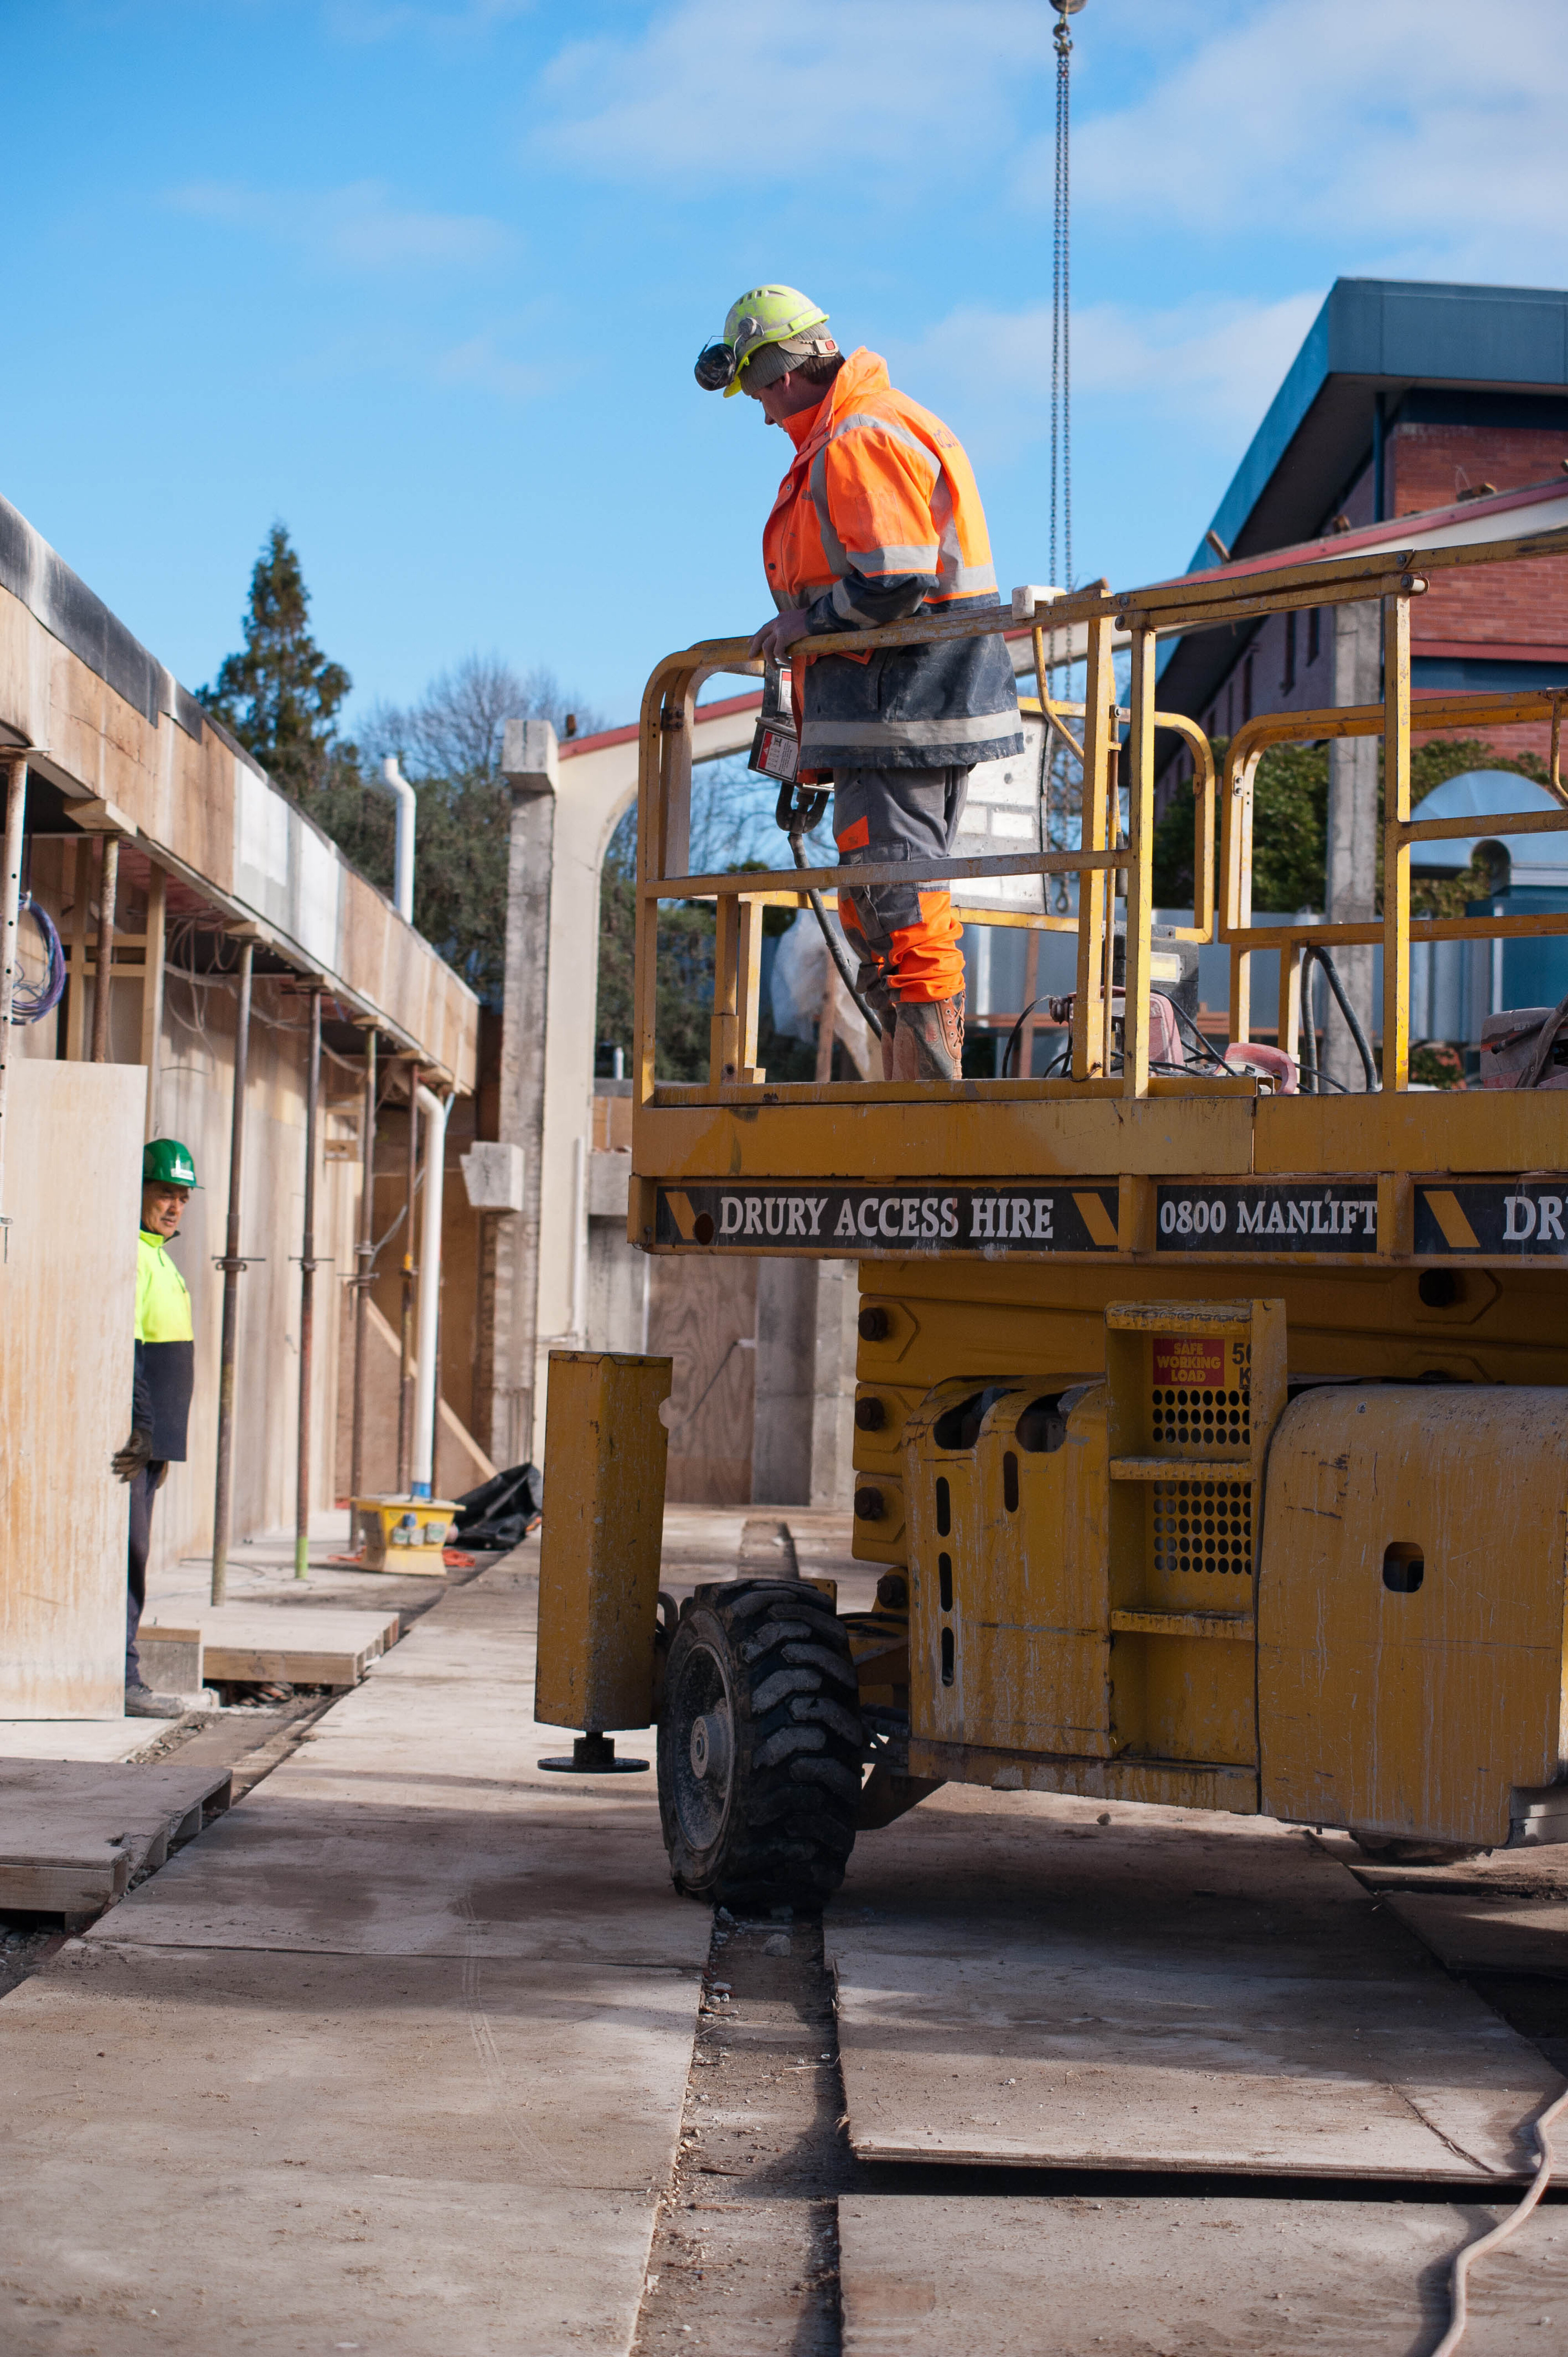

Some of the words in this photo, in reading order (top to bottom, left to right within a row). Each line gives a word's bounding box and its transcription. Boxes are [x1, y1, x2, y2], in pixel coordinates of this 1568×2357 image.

[719, 1197, 829, 1235] DRURY
[833, 1198, 958, 1238] ACCESS
[969, 1198, 1054, 1239] HIRE
[1161, 1201, 1226, 1234] 0800
[1236, 1201, 1377, 1234] MANLIFT
[1503, 1196, 1568, 1240] DR
[1174, 1343, 1203, 1355] SAFE
[1156, 1356, 1221, 1369] WORKING
[1171, 1370, 1206, 1383] LOAD
